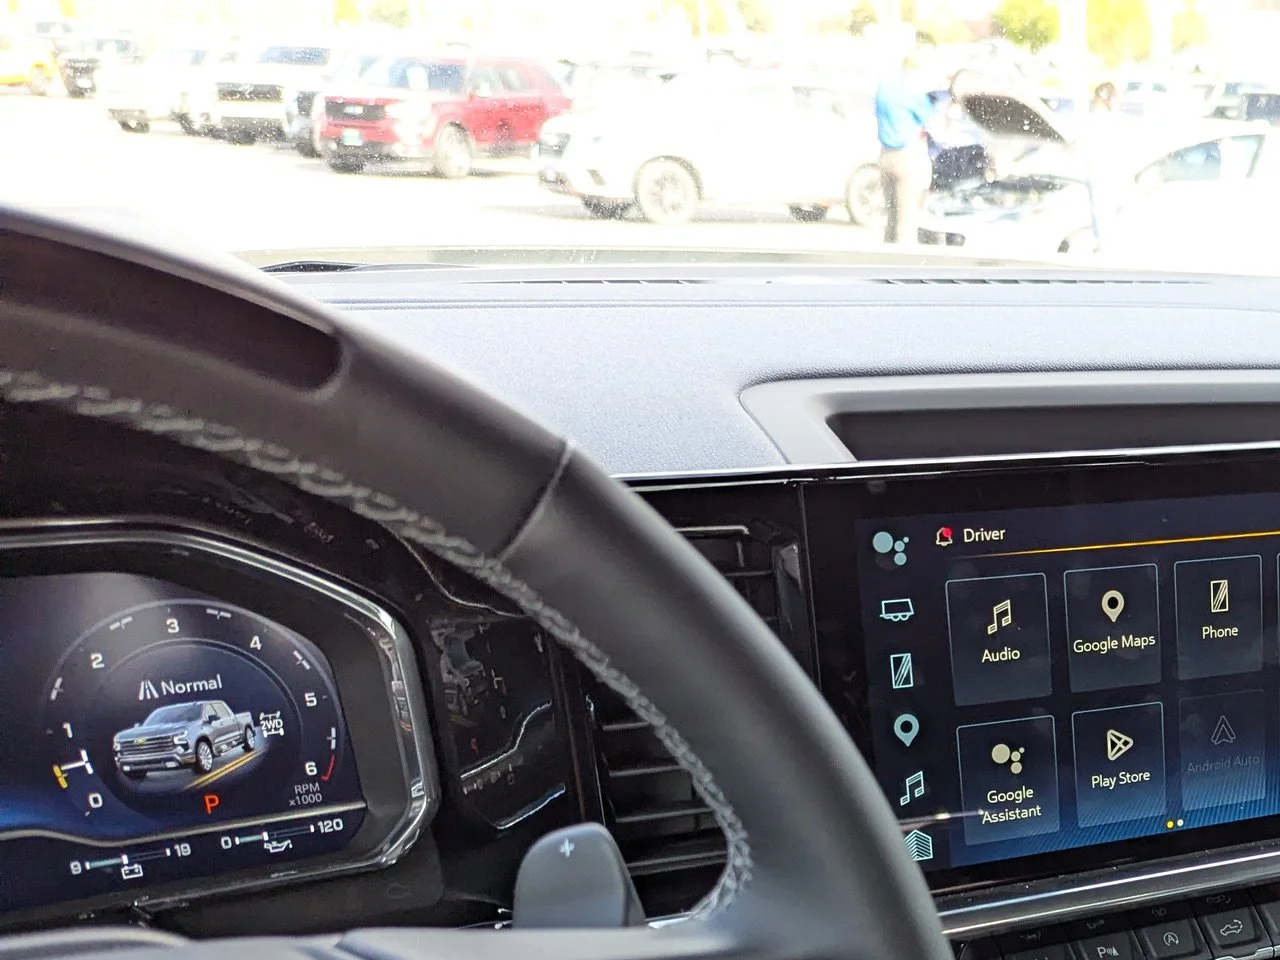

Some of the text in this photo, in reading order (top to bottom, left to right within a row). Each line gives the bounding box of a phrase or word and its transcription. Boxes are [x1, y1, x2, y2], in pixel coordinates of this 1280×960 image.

[963, 528, 1006, 543] Driver
[166, 617, 180, 634] 3
[1202, 625, 1239, 639] Phone
[250, 635, 262, 651] 4
[1073, 634, 1156, 655] Google Maps
[91, 653, 105, 669] 2
[982, 648, 1020, 663] Audio
[161, 674, 223, 697] Normal
[304, 692, 317, 707] 5
[63, 722, 74, 738] 1
[260, 718, 283, 731] 2WD
[305, 761, 317, 776] 6
[1187, 755, 1260, 773] Android Auto
[1092, 769, 1151, 790] Play Store
[294, 782, 320, 795] RPM
[987, 786, 1034, 804] Google
[89, 793, 103, 808] 0
[205, 794, 219, 814] P
[982, 804, 1042, 824] Assistant
[317, 818, 344, 834] 120
[221, 836, 232, 850] 0
[70, 861, 82, 875] 9
